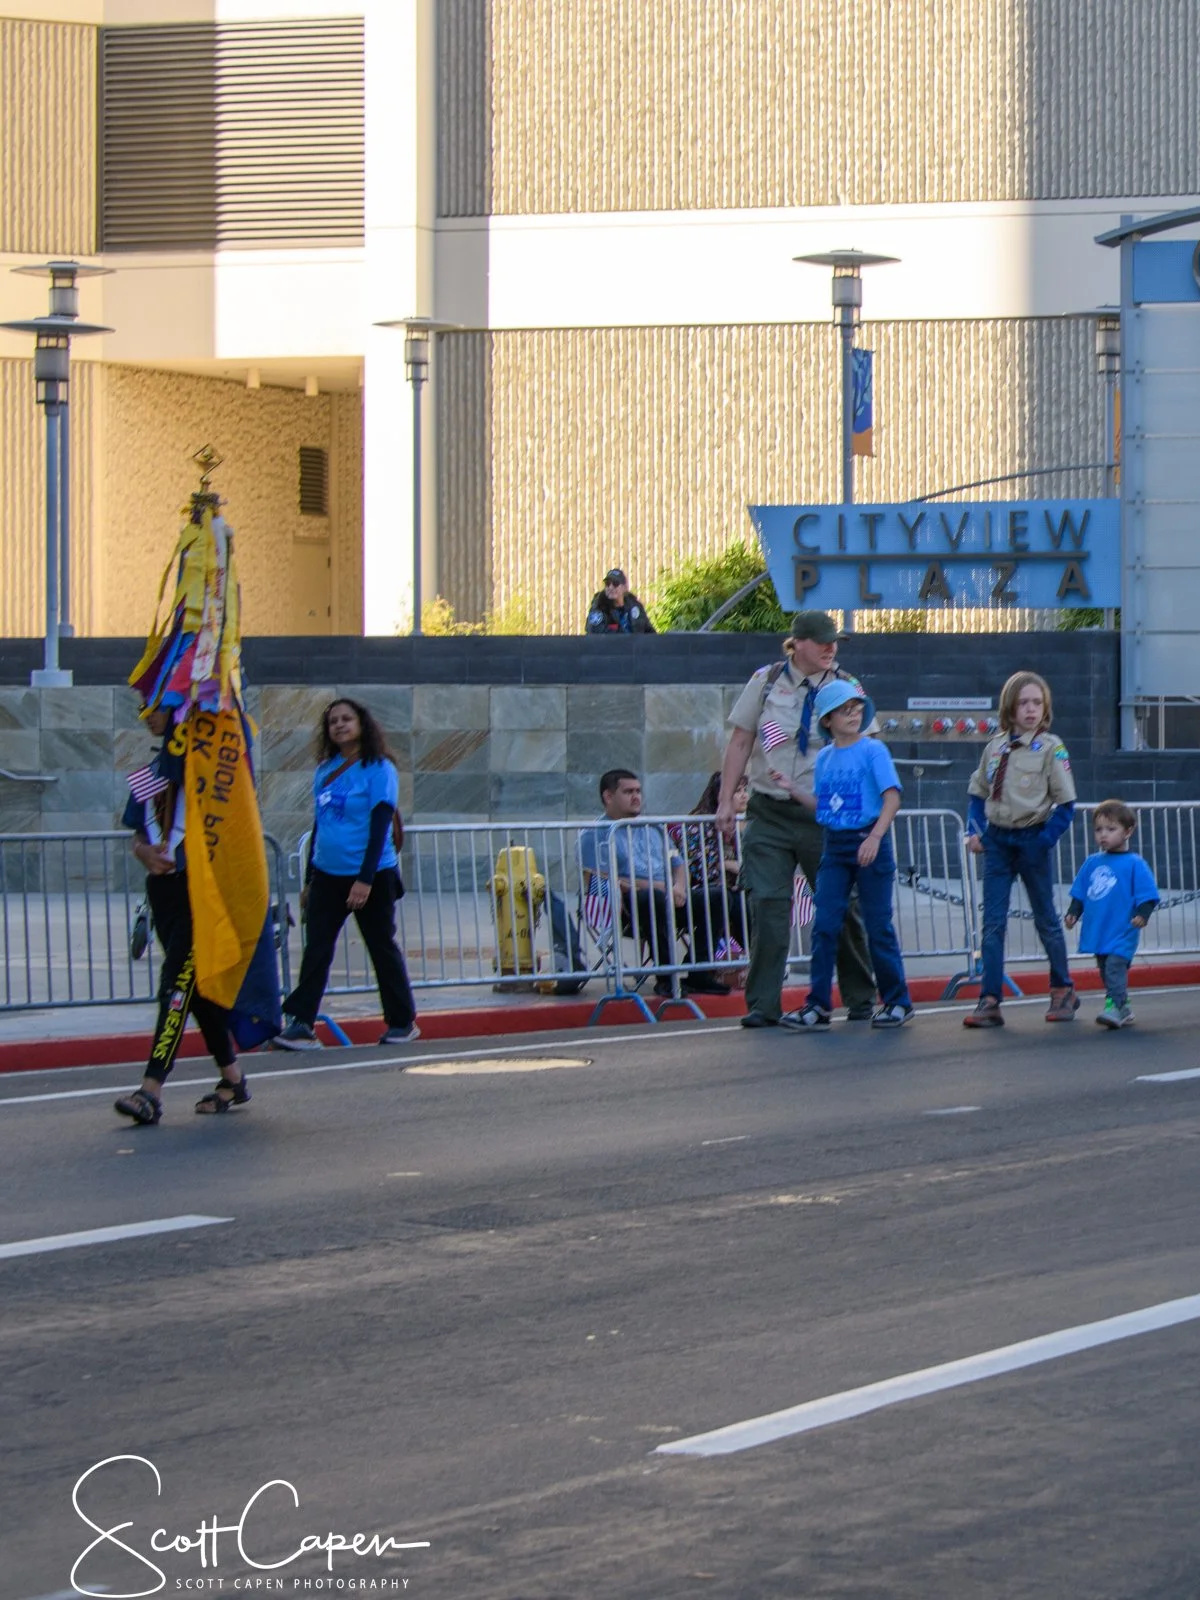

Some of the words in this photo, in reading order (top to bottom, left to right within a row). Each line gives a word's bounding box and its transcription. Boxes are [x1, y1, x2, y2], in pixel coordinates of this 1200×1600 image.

[793, 510, 1090, 552] CITYVIEW
[794, 560, 1091, 601] PLAZA
[211, 714, 242, 803] EGION
[152, 1007, 182, 1061] JEANS
